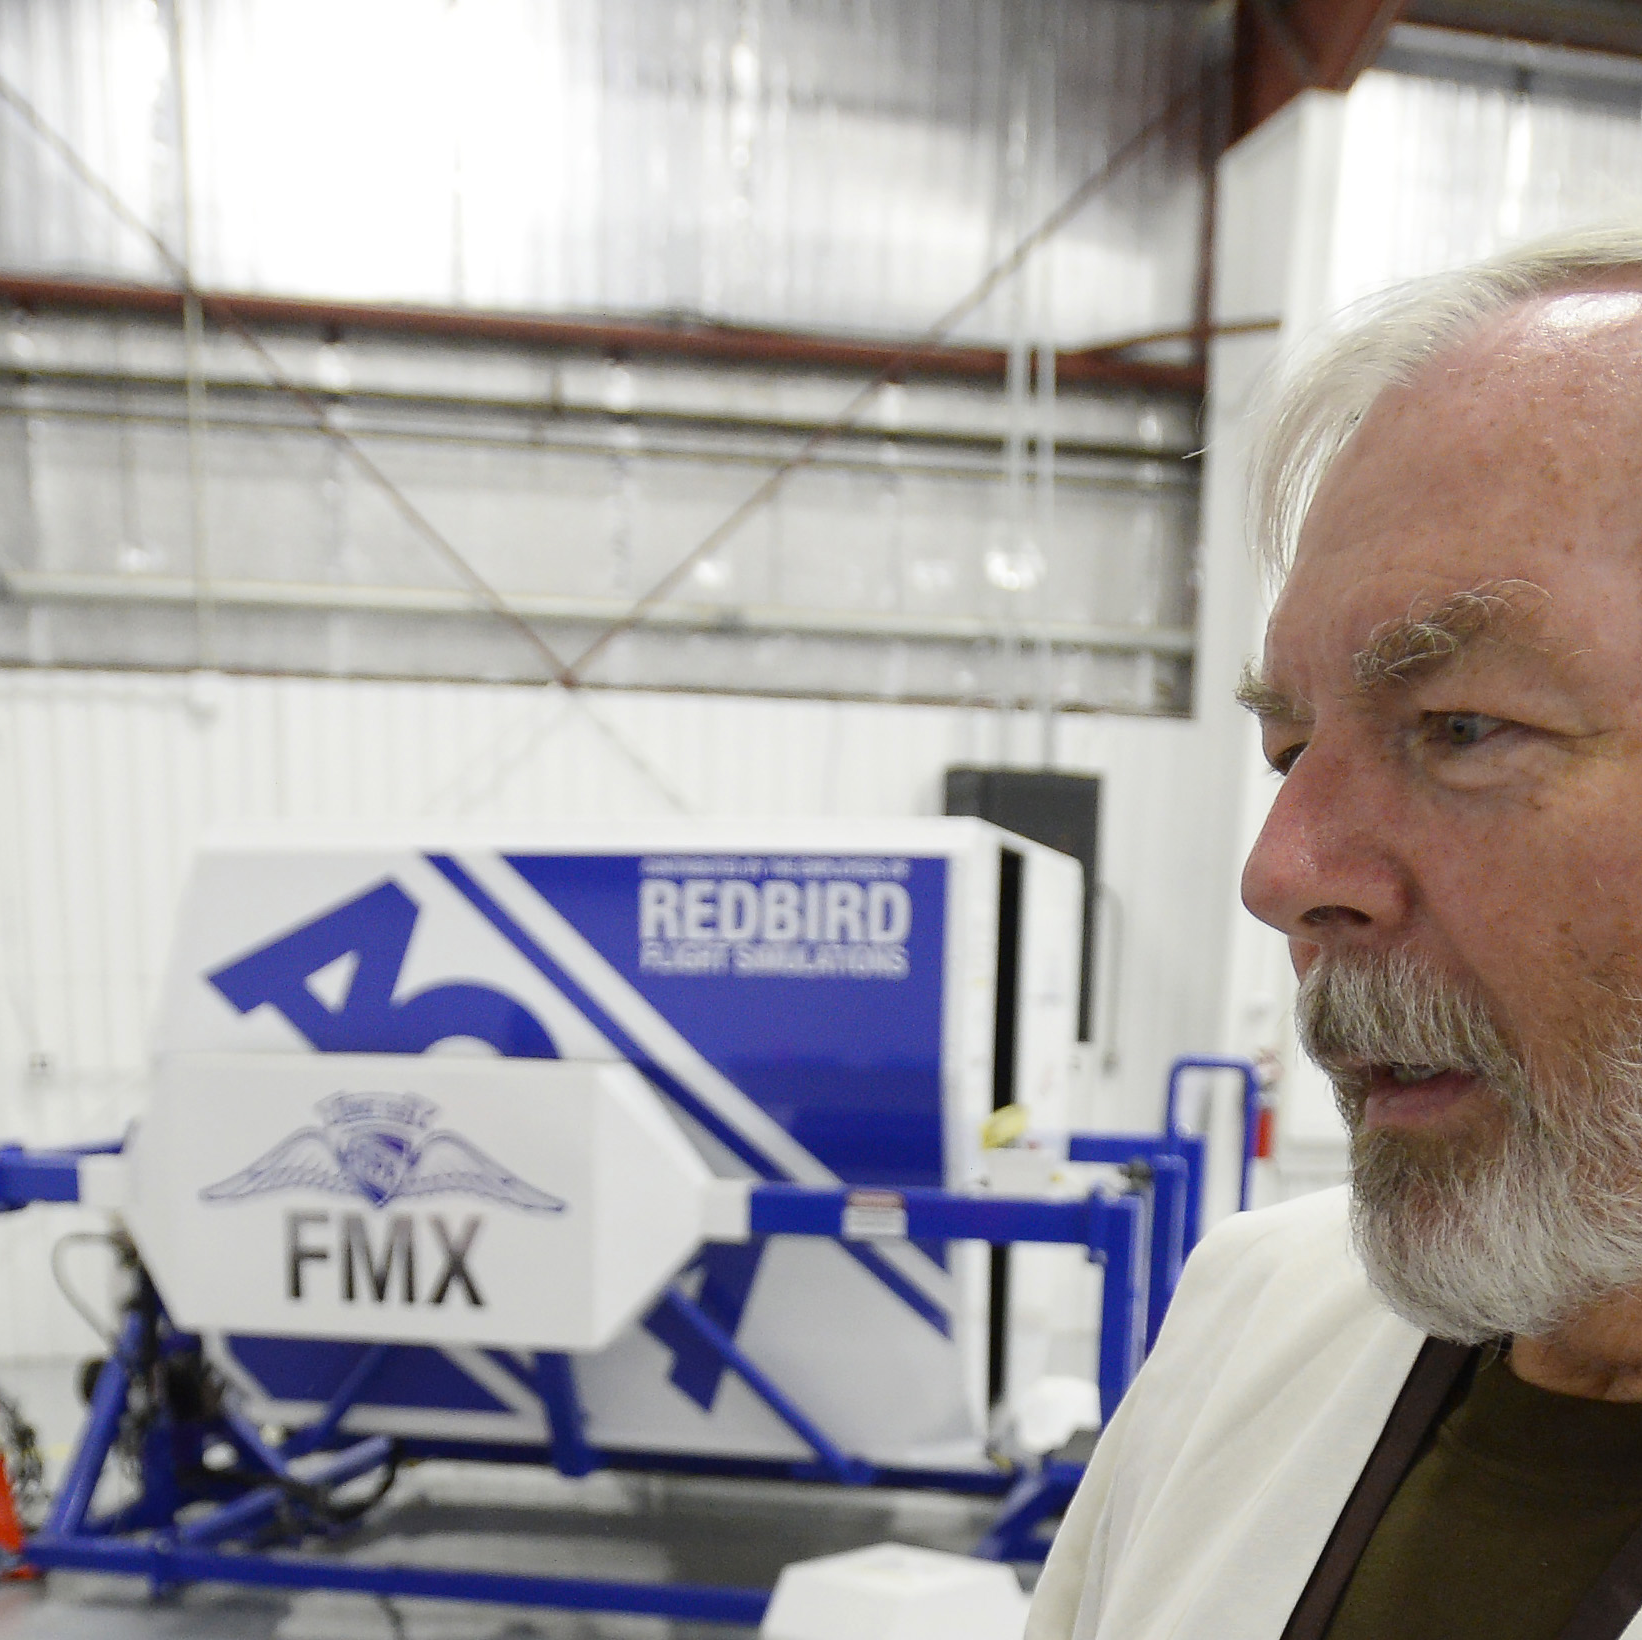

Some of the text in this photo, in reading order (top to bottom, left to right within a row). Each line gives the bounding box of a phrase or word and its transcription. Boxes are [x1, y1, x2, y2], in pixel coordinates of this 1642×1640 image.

[638, 878, 913, 943] REDBIRD
[639, 940, 730, 976] FLIGHT
[283, 1208, 487, 1307] FMX
